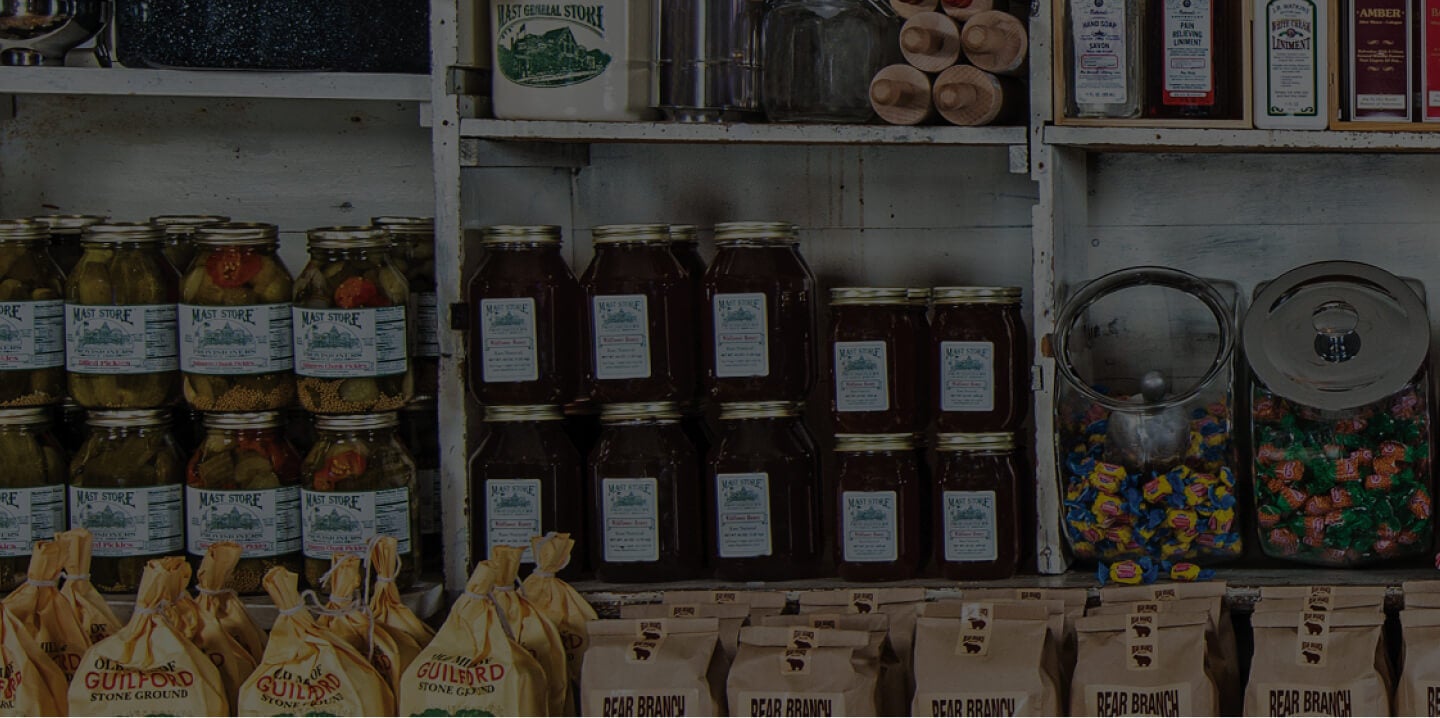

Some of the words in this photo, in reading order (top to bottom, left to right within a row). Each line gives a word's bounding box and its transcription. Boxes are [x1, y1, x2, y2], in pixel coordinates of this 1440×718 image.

[524, 4, 561, 17] GENERAL
[564, 5, 605, 31] STORE
[1360, 8, 1401, 18] AMBER
[1272, 35, 1311, 50] LINIMENT
[73, 307, 96, 326] MAST
[99, 308, 134, 326] STORE
[192, 308, 217, 326] MAST
[220, 308, 256, 327] STORE
[301, 311, 326, 328] MAST
[327, 312, 362, 329] STORE
[77, 491, 99, 508] MAST
[102, 491, 136, 508] STORE
[200, 492, 225, 510] MAST
[229, 493, 263, 510] STORE
[306, 493, 330, 510] MAST
[333, 495, 362, 512] STORE
[85, 671, 194, 690] GUILFORD
[418, 681, 455, 696] STONE
[90, 691, 132, 702] STONE
[135, 689, 188, 700] GROUND
[1097, 691, 1128, 717] BEAR
[1131, 690, 1179, 717] BRANCH
[1269, 690, 1299, 717] BEAR
[1304, 690, 1352, 717] BRANCH
[603, 697, 633, 717] BEAR
[638, 695, 685, 717] BRANCH
[751, 699, 782, 717] BEAR
[786, 699, 832, 717] BRANCH
[932, 700, 962, 717] BEAR
[967, 698, 1015, 717] BRANCH
